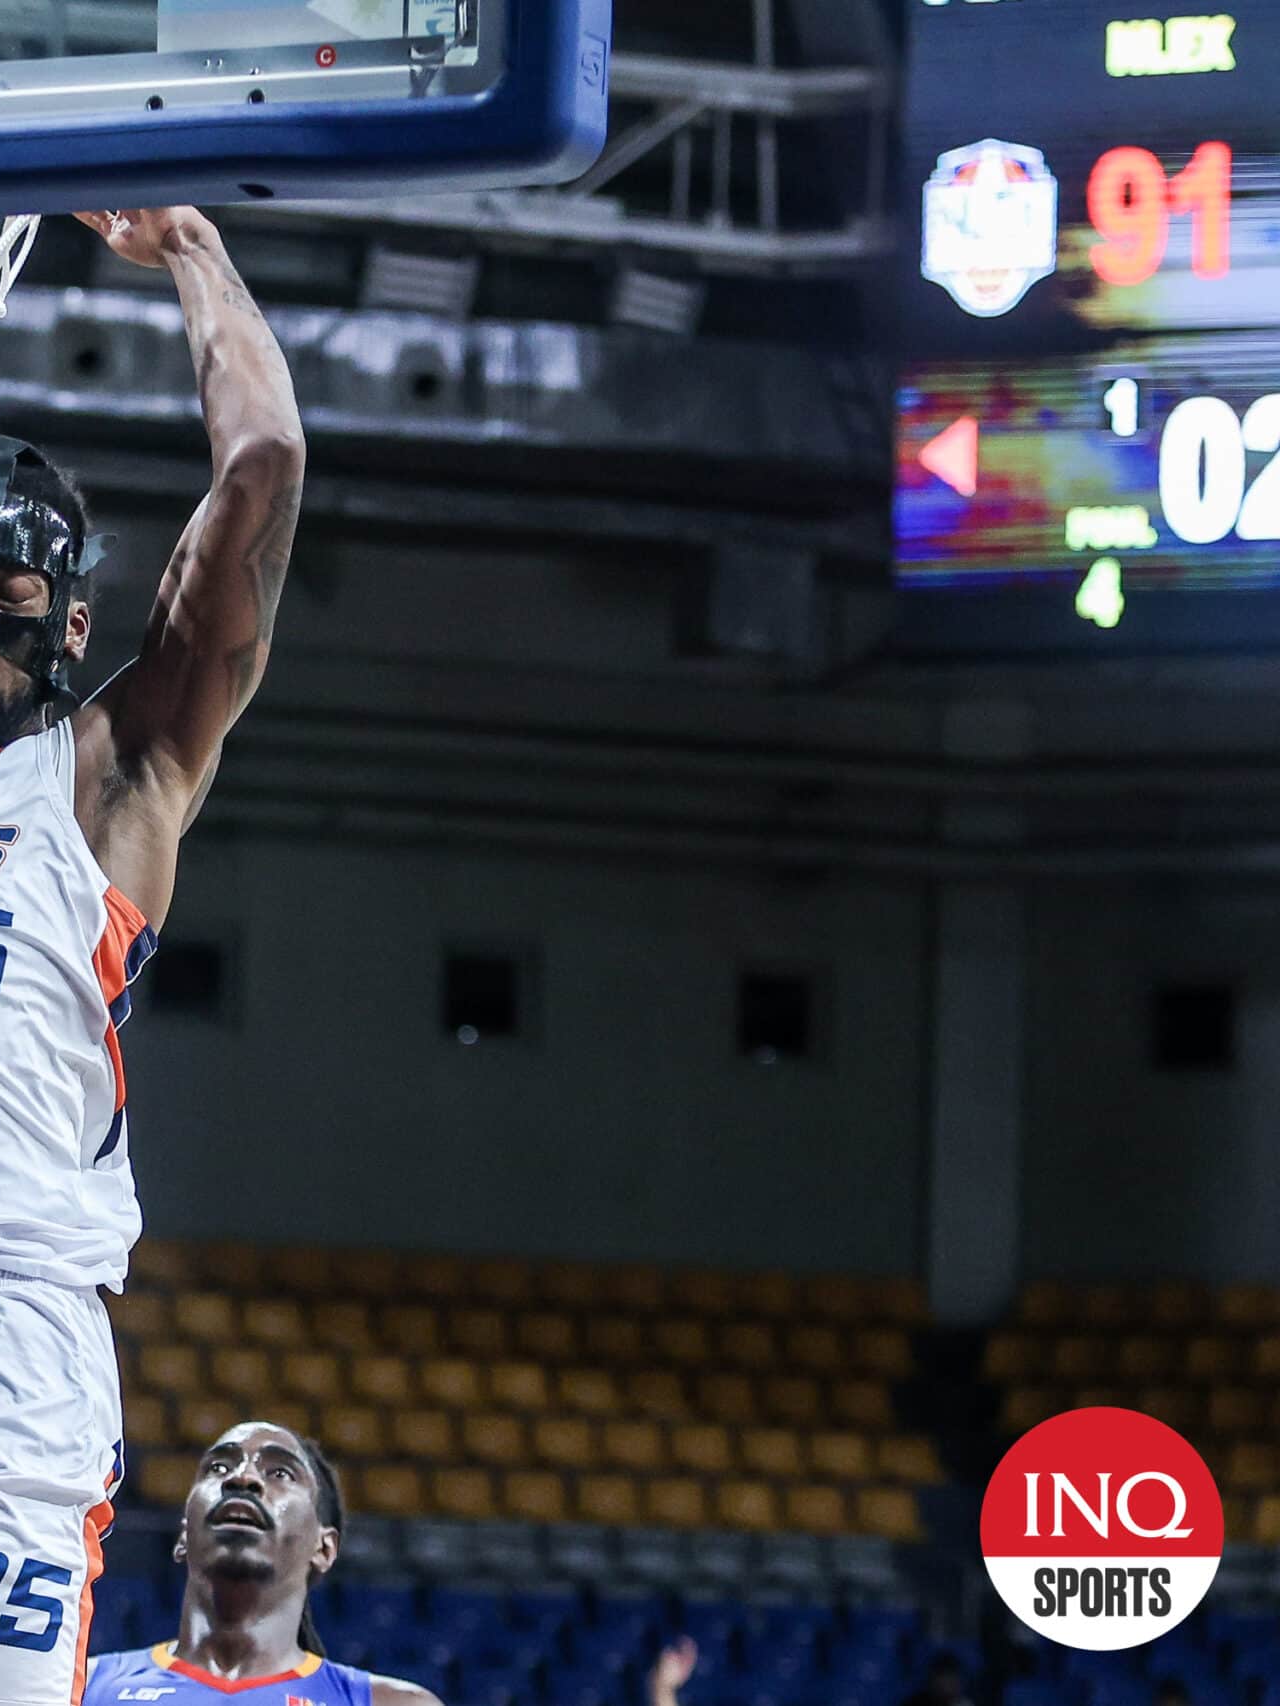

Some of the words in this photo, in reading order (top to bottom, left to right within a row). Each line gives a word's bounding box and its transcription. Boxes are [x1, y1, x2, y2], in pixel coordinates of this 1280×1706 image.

[1087, 141, 1232, 286] 91
[1104, 377, 1138, 437] 1
[1075, 556, 1124, 628] 4
